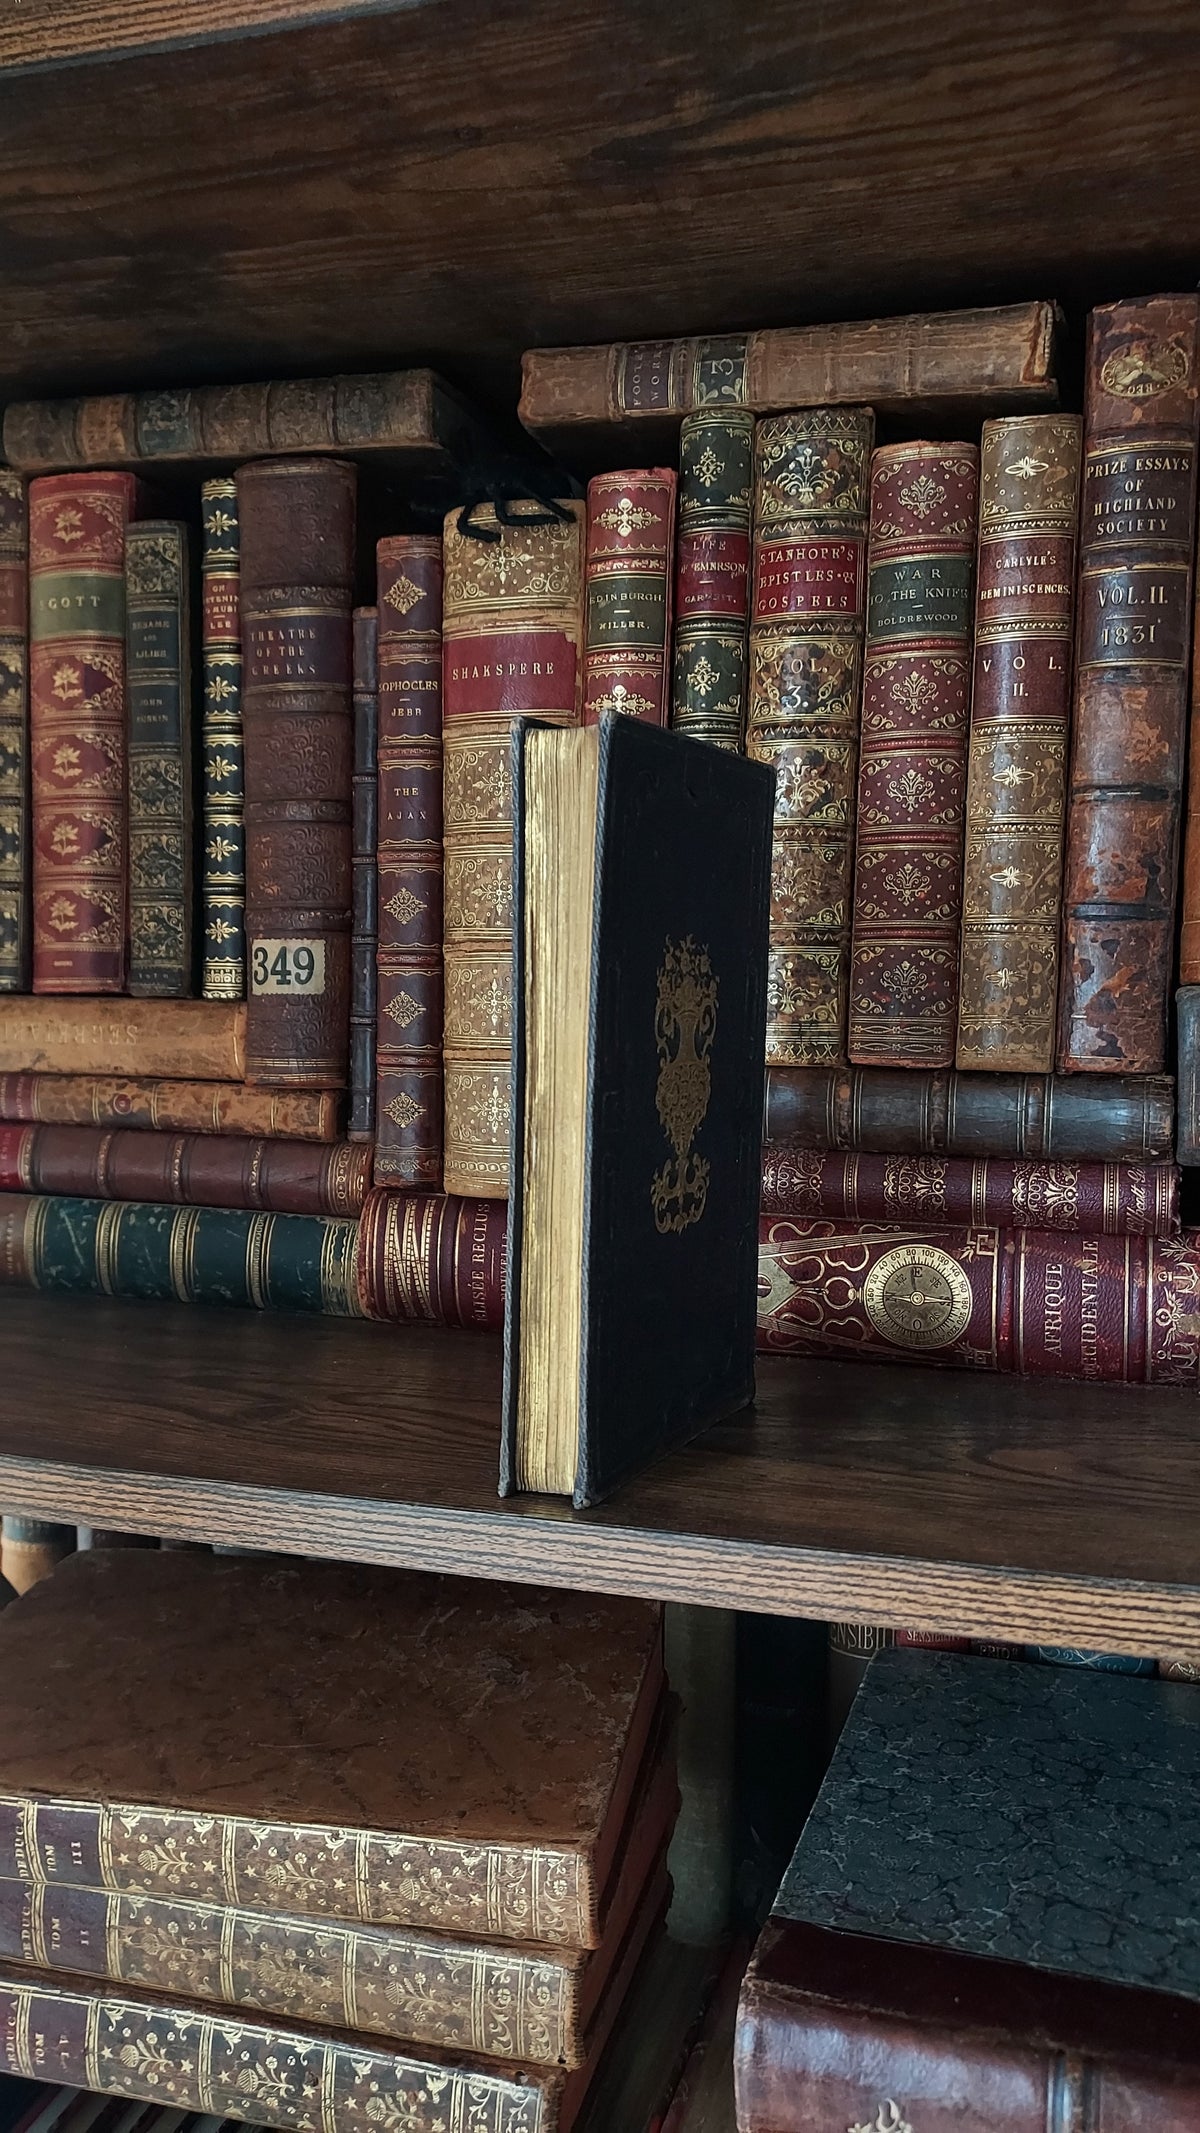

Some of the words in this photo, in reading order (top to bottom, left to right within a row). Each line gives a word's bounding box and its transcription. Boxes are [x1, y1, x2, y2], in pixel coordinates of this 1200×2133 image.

[1087, 459, 1128, 479] PRIZE
[1136, 457, 1190, 472] ESSAYS
[1124, 479, 1145, 493] OF
[1093, 497, 1177, 516] HIGHLAND
[1096, 518, 1169, 536] SOCIETY
[693, 540, 727, 551] LIFE
[760, 545, 855, 566] STANHOPE'S
[995, 551, 1057, 569] CARLYLE'S
[894, 568, 942, 581] WAR
[758, 595, 848, 611] GOSPELS
[870, 593, 884, 605] TO
[890, 589, 917, 601] THE
[925, 587, 968, 599] KNIFE
[1098, 586, 1145, 608] VOL.
[1150, 585, 1169, 605] II.
[877, 613, 958, 627] BOLDREWOOD
[250, 628, 317, 642] THEATRE
[1101, 623, 1156, 647] 1831
[256, 646, 271, 658] OF
[278, 645, 305, 657] THE
[251, 663, 317, 676] GREEKS
[452, 662, 554, 681] SHAKSPERE
[774, 658, 828, 675] VOL.
[982, 656, 1063, 673] VOL.
[378, 680, 438, 693] SOPHOCLES
[1012, 682, 1029, 697] II.
[394, 787, 419, 797] THE
[387, 811, 426, 821] AJAX
[253, 945, 315, 986] 349
[471, 1203, 490, 1264] RECLUS
[890, 1252, 901, 1261] 60
[905, 1248, 917, 1256] 80
[921, 1249, 935, 1258] 100
[912, 1266, 923, 1278] E
[468, 1270, 488, 1321] ÉLISÉE
[1044, 1263, 1066, 1358] AFRIQUE
[44, 1844, 57, 1872] TOM
[70, 1841, 83, 1865] III
[51, 1917, 62, 1950] TOM
[80, 1929, 90, 1946] II
[35, 2032, 45, 2065] TOM
